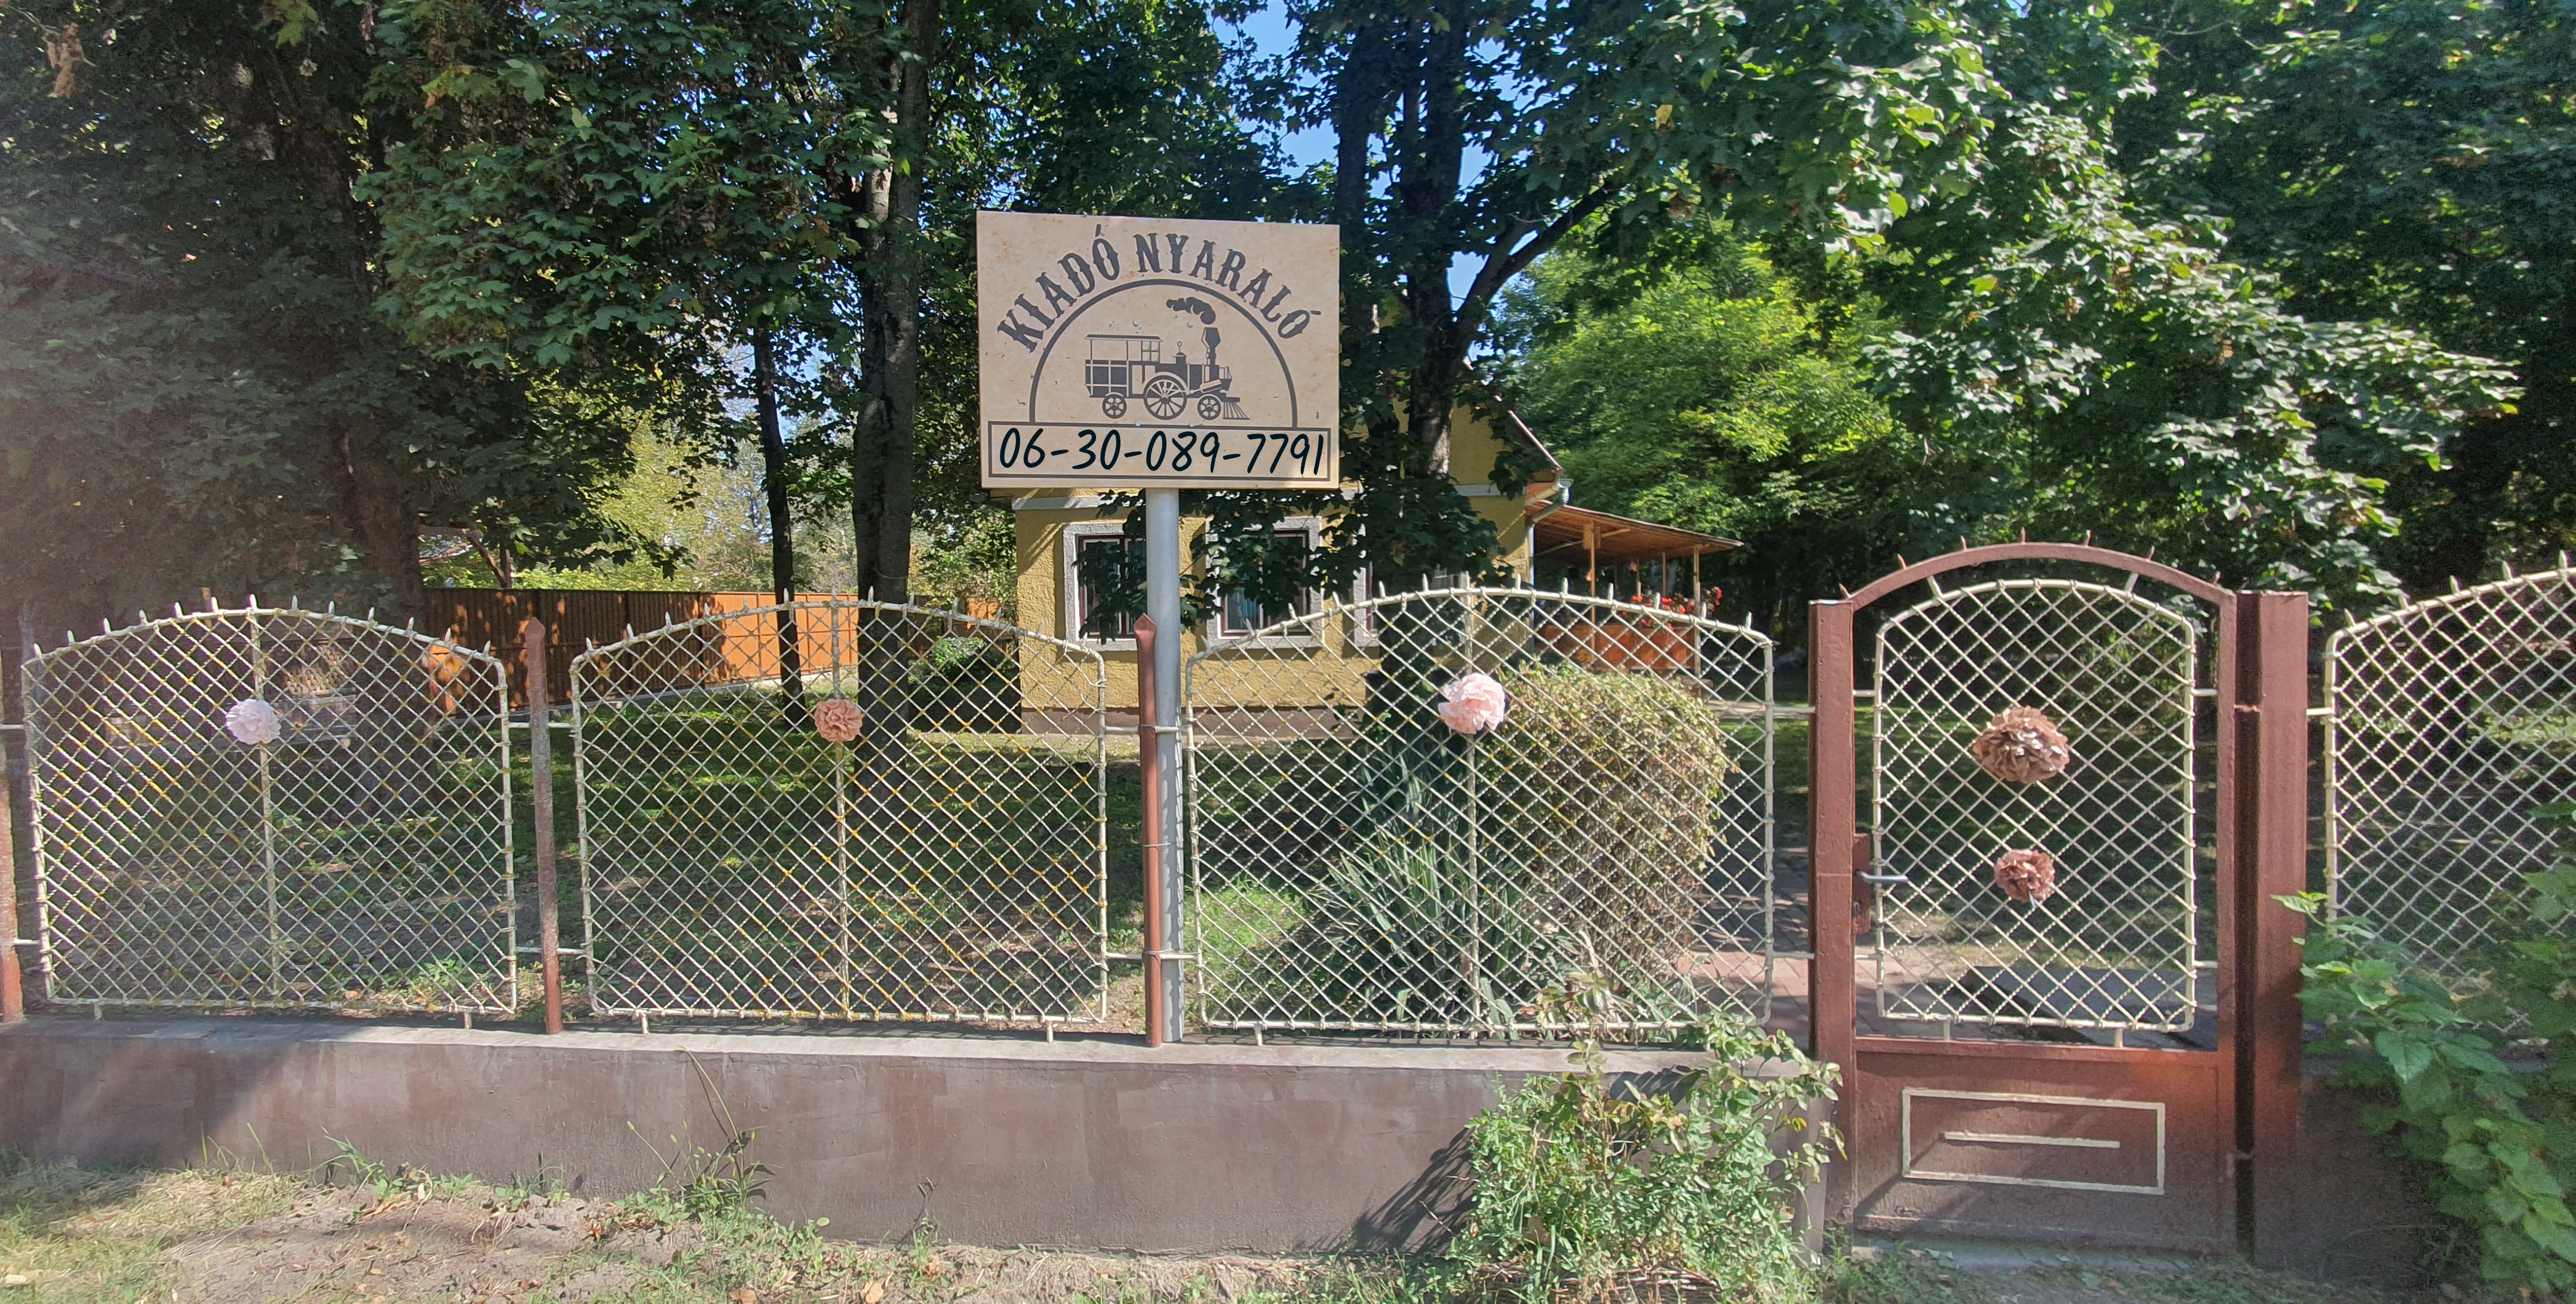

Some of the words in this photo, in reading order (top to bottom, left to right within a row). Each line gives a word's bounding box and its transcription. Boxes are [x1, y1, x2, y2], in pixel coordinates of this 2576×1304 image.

[997, 224, 1120, 353] KIADÓ
[1132, 233, 1321, 339] NYARALÓ
[999, 428, 1324, 475] 06-30-089-7791
